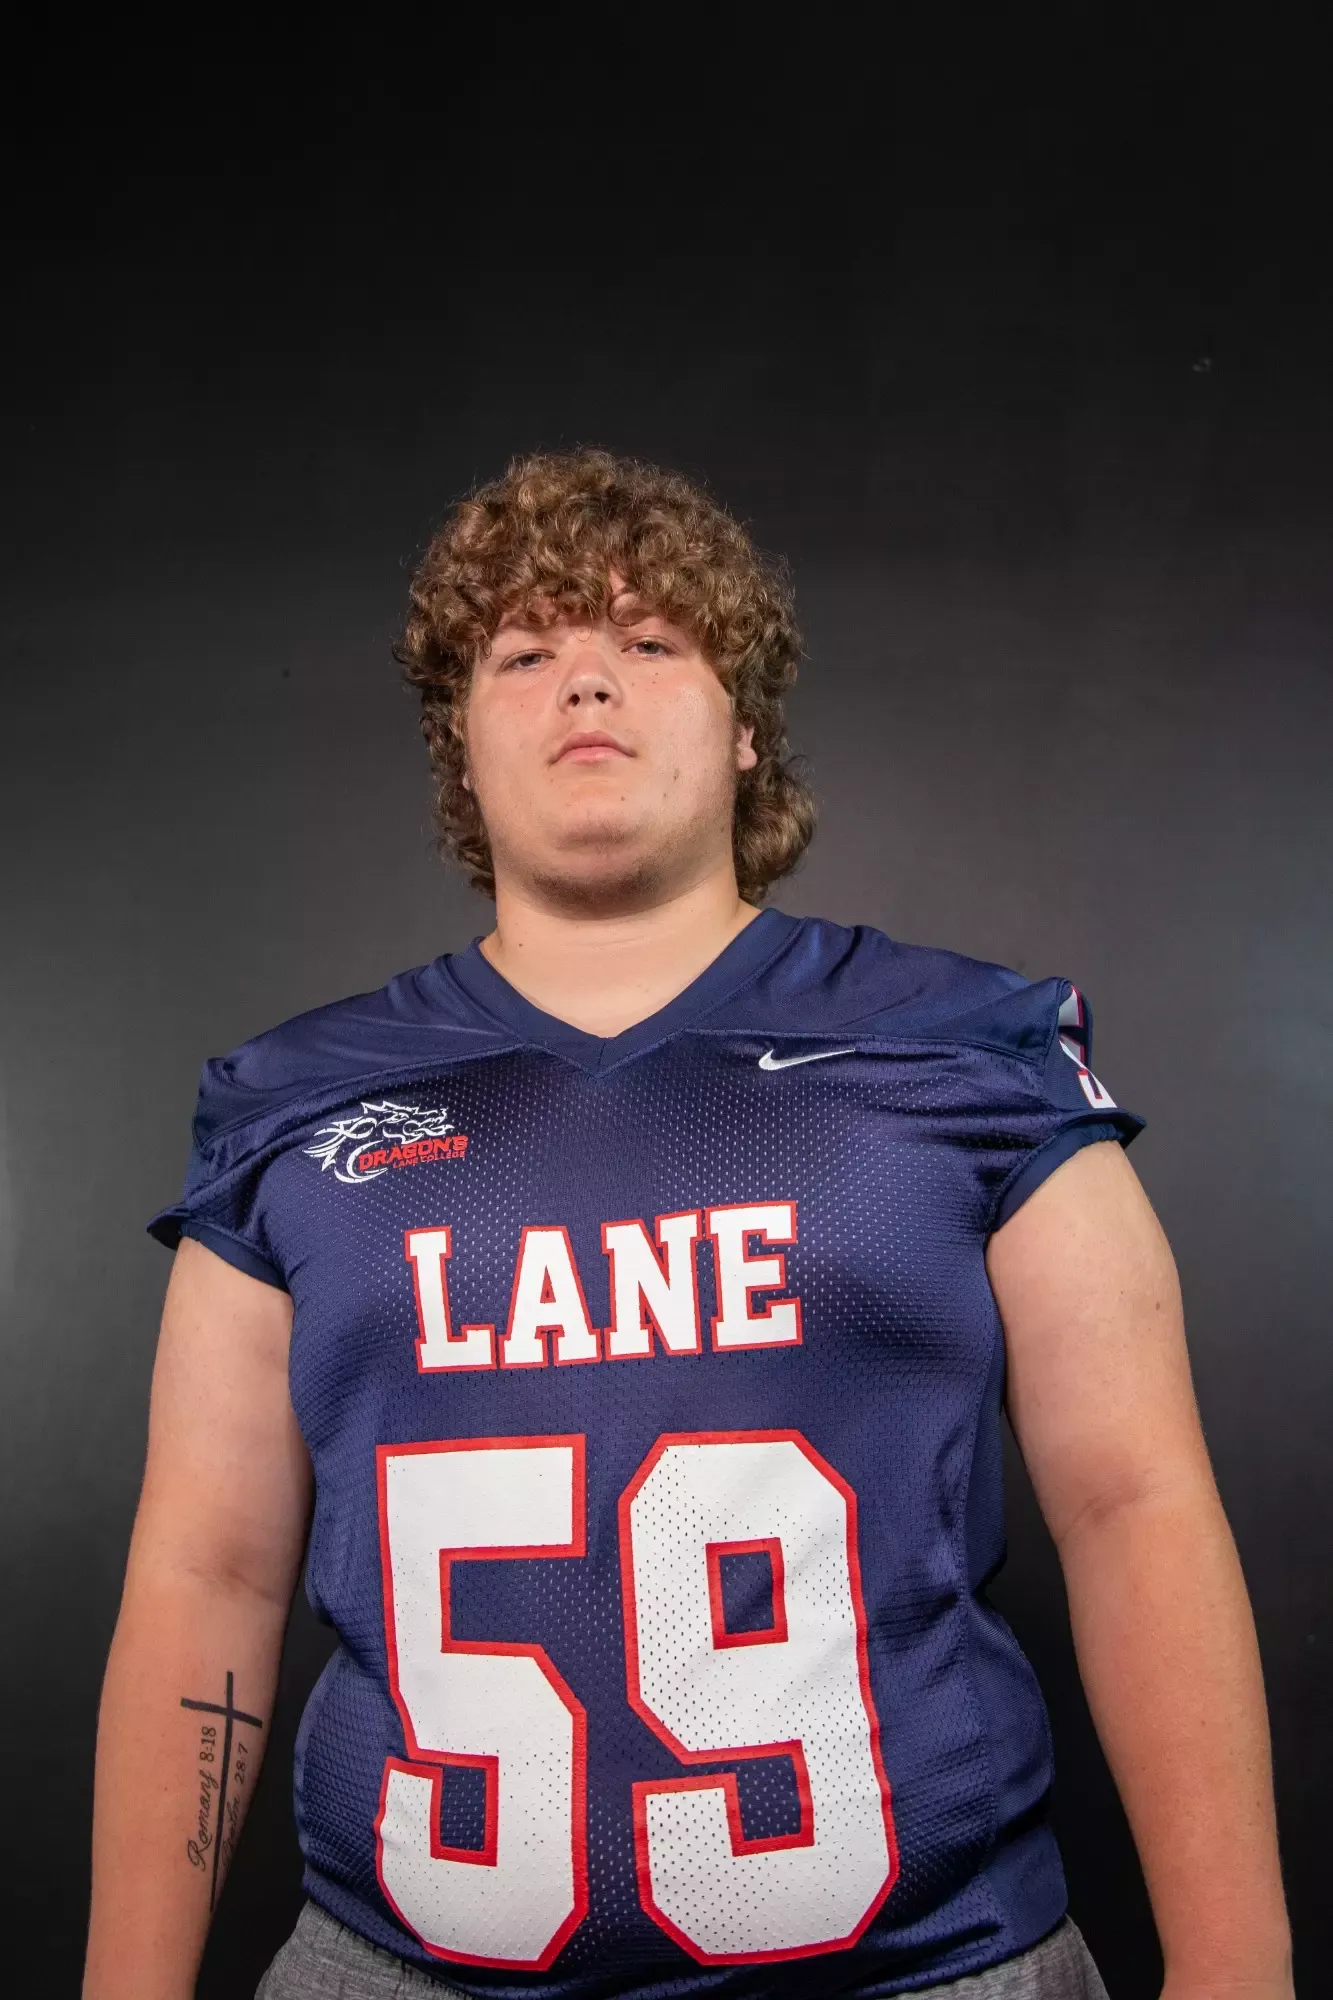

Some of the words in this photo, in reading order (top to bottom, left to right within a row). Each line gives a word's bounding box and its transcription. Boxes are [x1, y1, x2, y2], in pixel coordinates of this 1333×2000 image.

[359, 1135, 468, 1171] DRAGONS
[393, 1158, 418, 1168] LANE
[421, 1150, 466, 1163] COLLEGE
[404, 1200, 803, 1372] LANE
[375, 1429, 900, 1972] 59
[200, 1726, 217, 1762] 8:18
